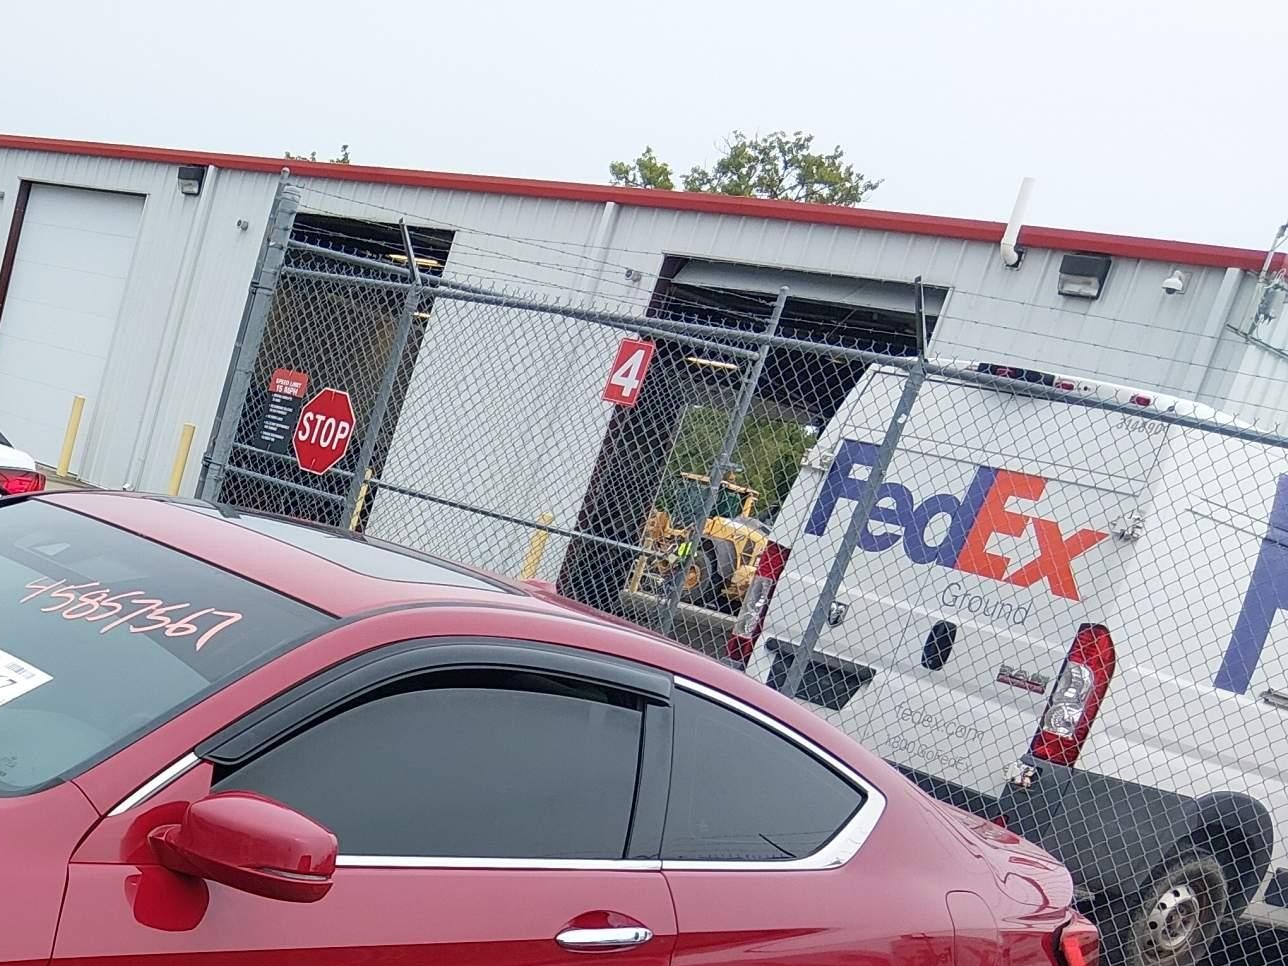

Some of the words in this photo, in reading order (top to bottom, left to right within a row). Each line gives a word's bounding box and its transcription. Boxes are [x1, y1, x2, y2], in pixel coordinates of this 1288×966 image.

[276, 384, 283, 392] 15
[284, 387, 298, 396] MPH
[610, 349, 646, 397] 4
[298, 411, 350, 450] STOP
[804, 438, 1110, 602] FedEx
[20, 576, 243, 651] 45857567
[941, 582, 1033, 625] Ground
